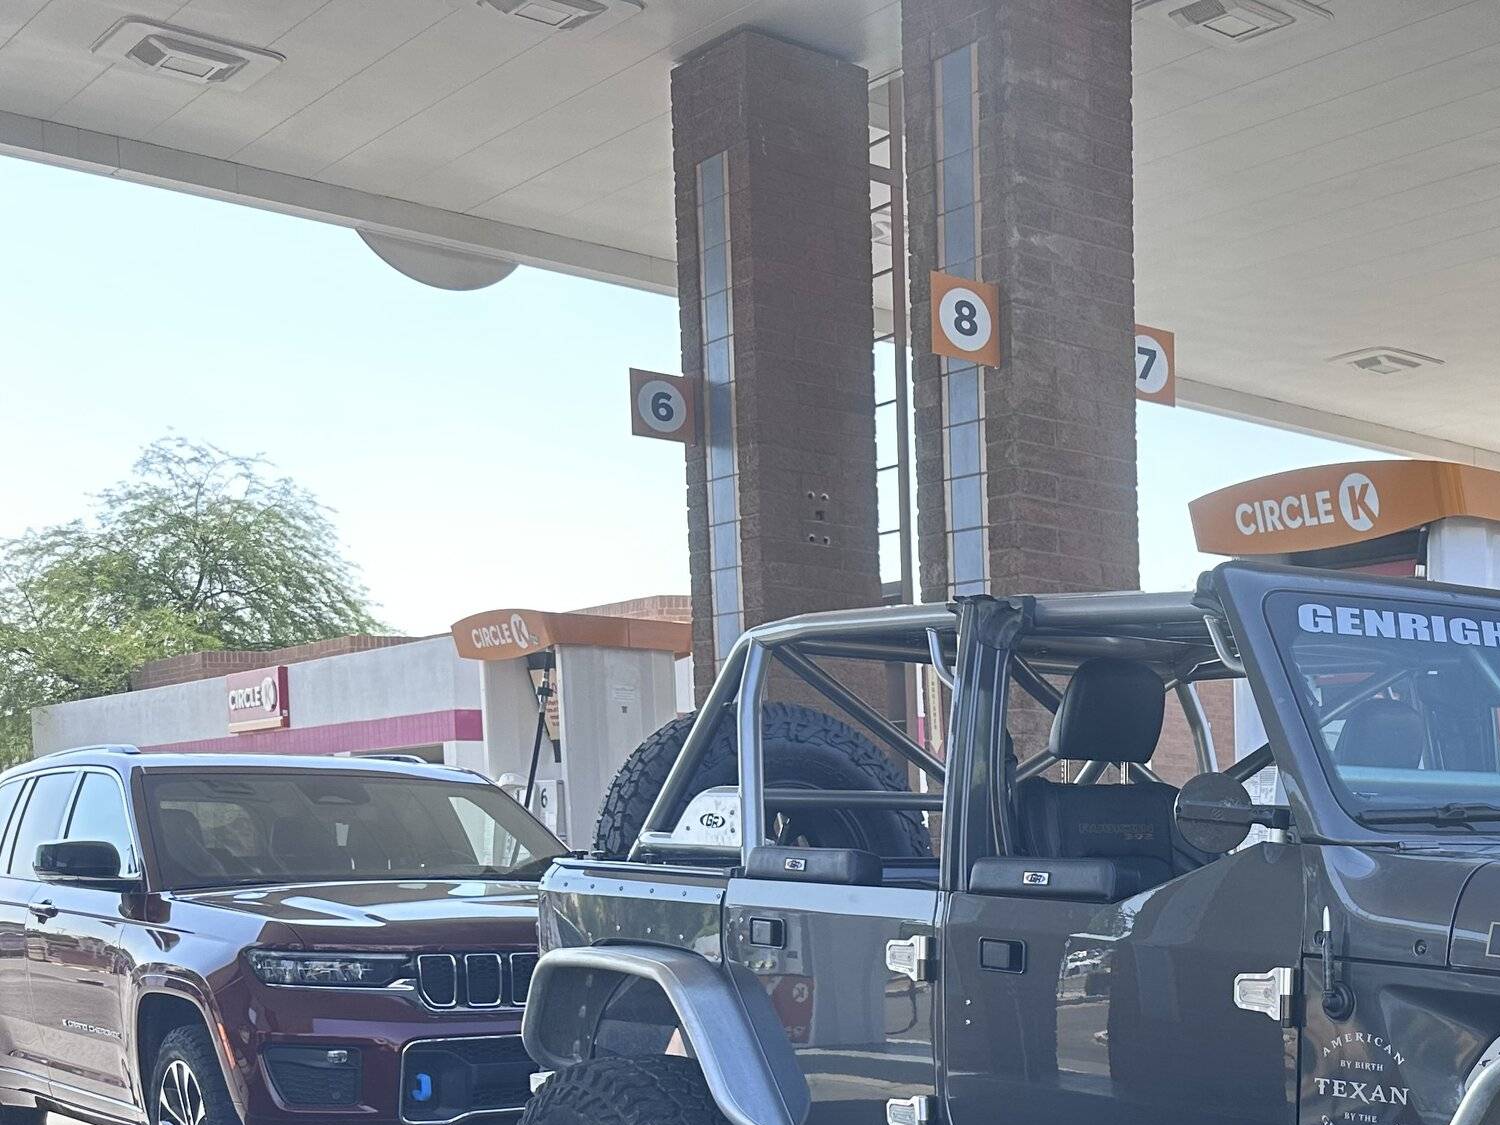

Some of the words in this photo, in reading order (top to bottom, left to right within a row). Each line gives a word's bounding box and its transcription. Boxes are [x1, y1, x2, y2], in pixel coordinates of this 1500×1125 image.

[954, 300, 978, 336] 8
[1137, 346, 1157, 380] 7
[651, 391, 674, 421] 6
[1235, 490, 1335, 535] CIRCLE
[1342, 476, 1379, 530] K
[471, 623, 513, 649] CIRCLE
[511, 614, 528, 648] K
[229, 686, 261, 710] CIRCLE
[262, 678, 277, 711] K
[540, 787, 549, 809] 6
[1322, 1032, 1404, 1065] AMERICAN
[1340, 1060, 1352, 1068] BY
[1355, 1062, 1383, 1071] BIRTH
[1314, 1077, 1409, 1105] TEXAN
[1344, 1112, 1356, 1121] BY
[1359, 1114, 1377, 1123] THE
